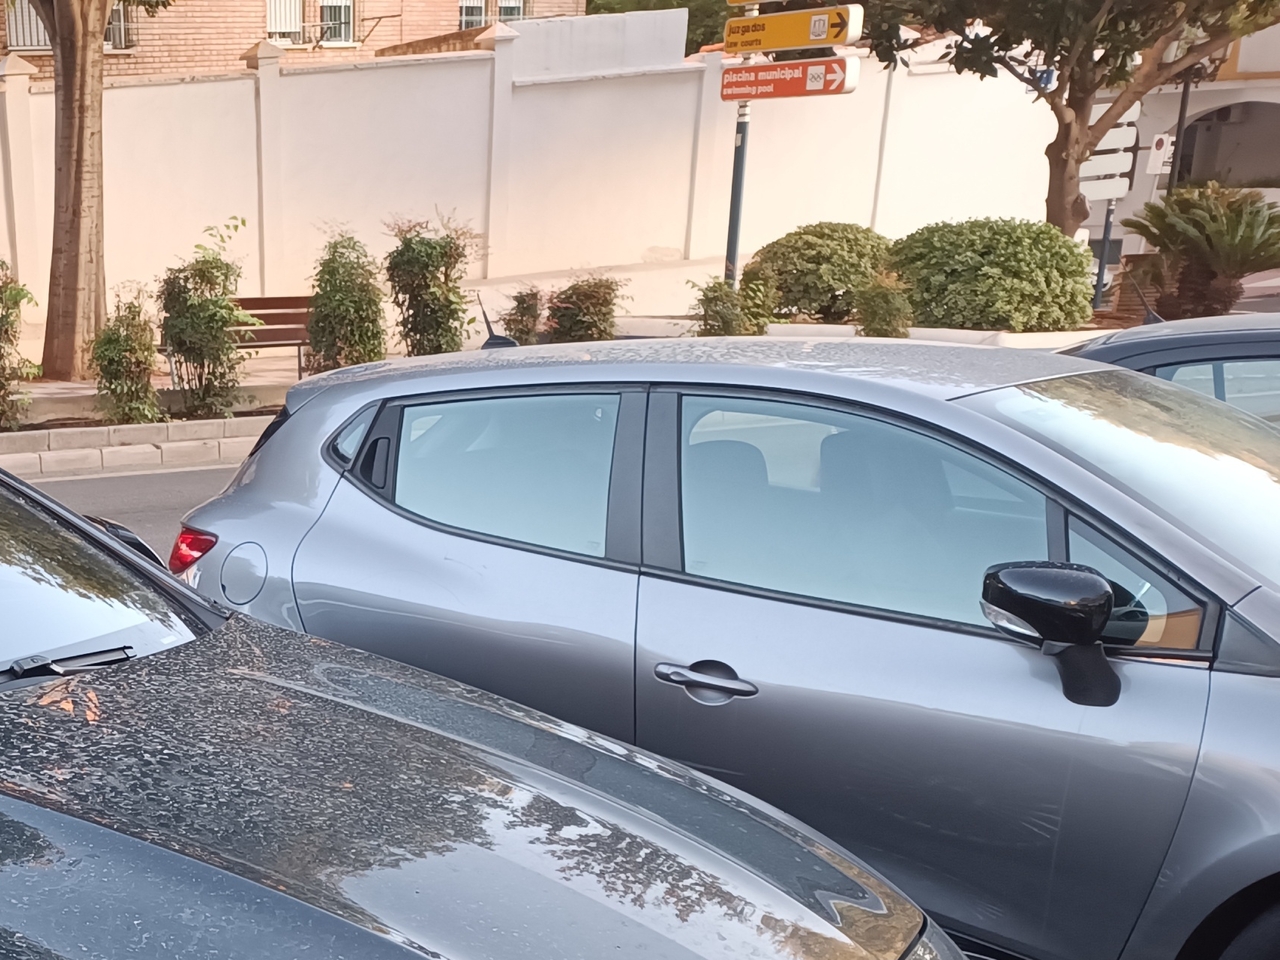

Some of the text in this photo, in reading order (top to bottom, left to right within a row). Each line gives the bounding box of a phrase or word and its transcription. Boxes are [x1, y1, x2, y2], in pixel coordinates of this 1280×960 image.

[727, 23, 765, 37] juzgados
[741, 39, 761, 47] courts
[723, 66, 802, 85] piscina municipal
[723, 83, 774, 95] swimming pool
